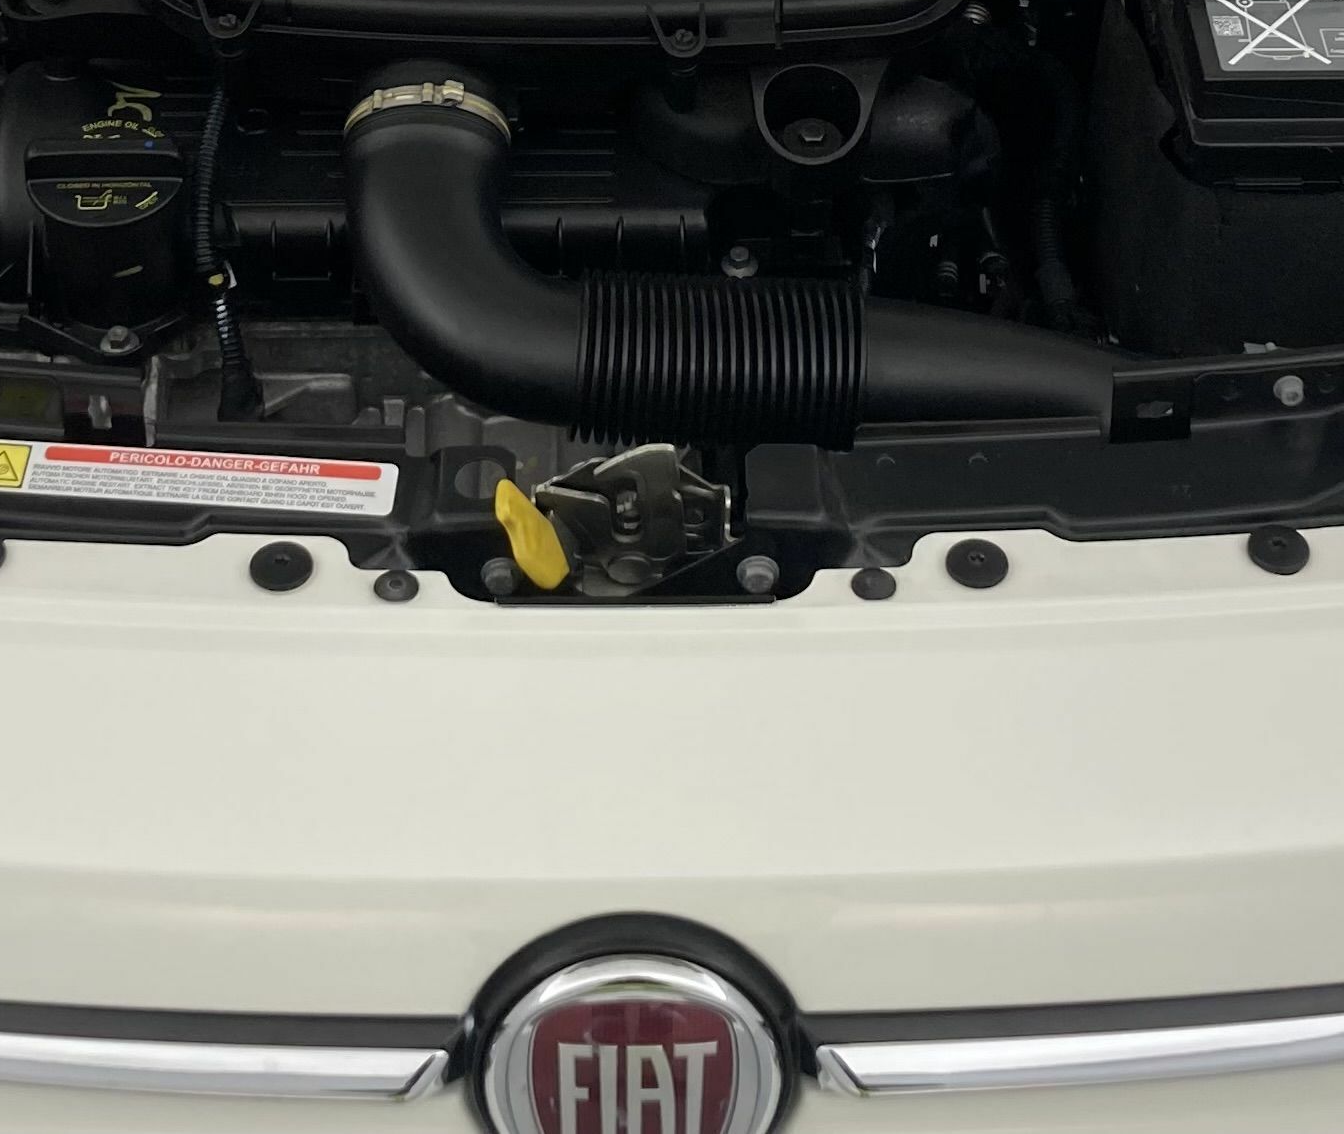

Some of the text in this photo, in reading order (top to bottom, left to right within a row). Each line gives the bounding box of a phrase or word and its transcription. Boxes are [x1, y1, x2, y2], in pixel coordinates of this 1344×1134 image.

[81, 119, 139, 132] ENGINE OIL
[109, 452, 321, 474] PERICOLO-DANGER-GEFAHR
[558, 1041, 718, 1134] FIAT
